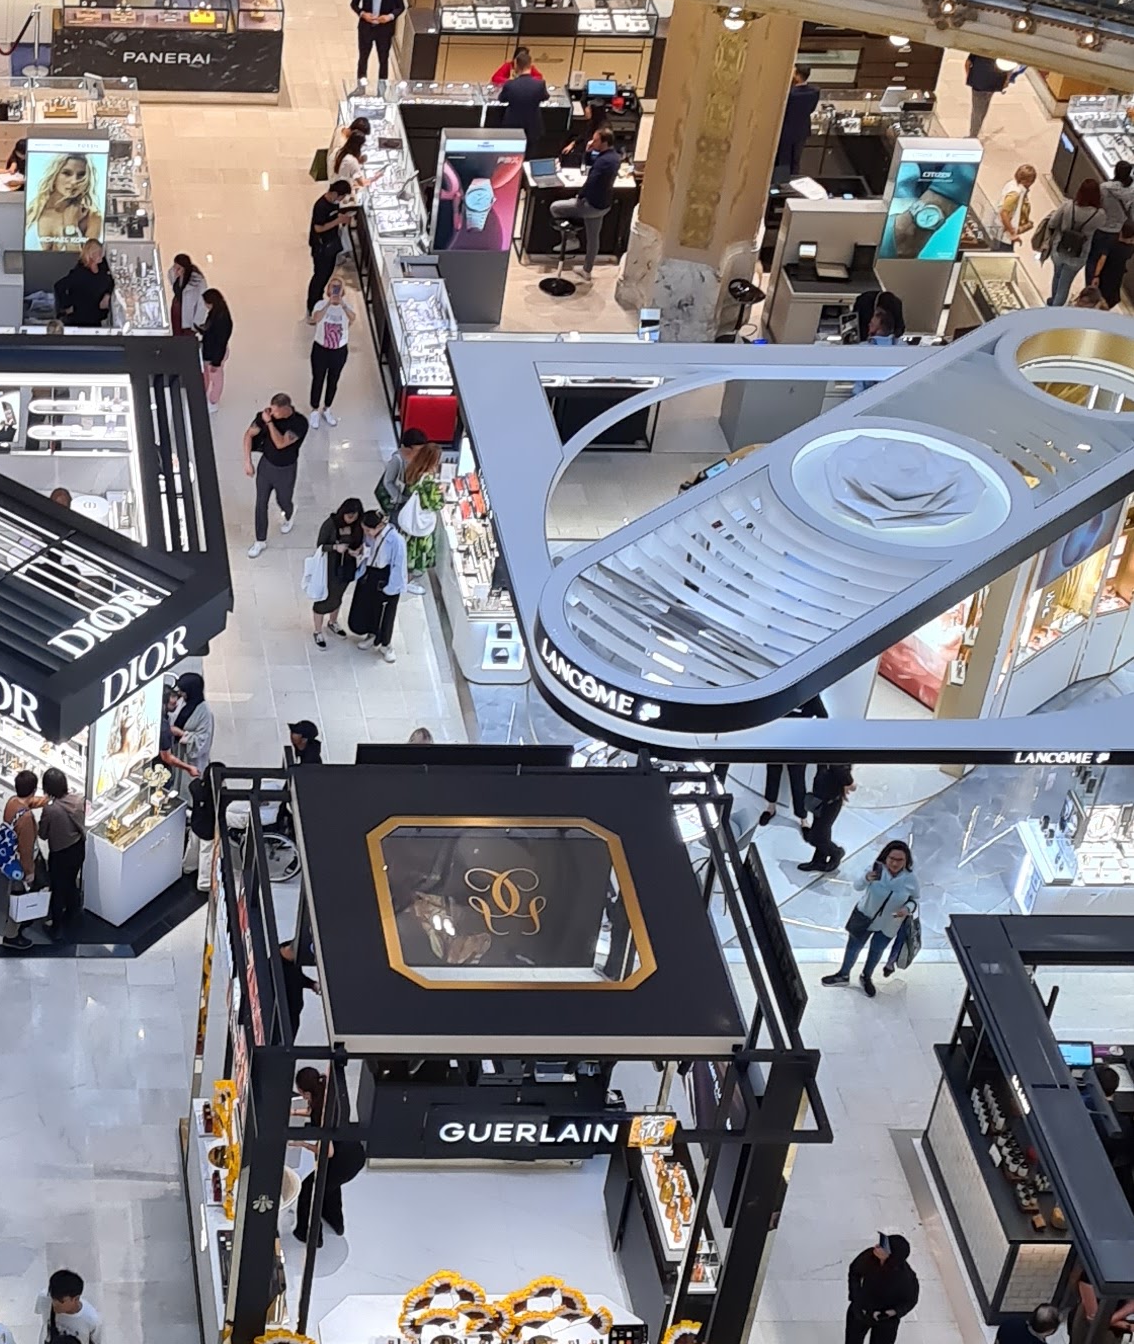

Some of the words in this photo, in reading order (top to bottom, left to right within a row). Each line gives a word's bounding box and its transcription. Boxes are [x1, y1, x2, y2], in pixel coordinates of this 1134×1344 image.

[123, 51, 211, 65] PANERAI
[47, 587, 164, 659] DIOR
[101, 625, 188, 712] DIOR
[439, 1123, 618, 1143] GUERLAIN
